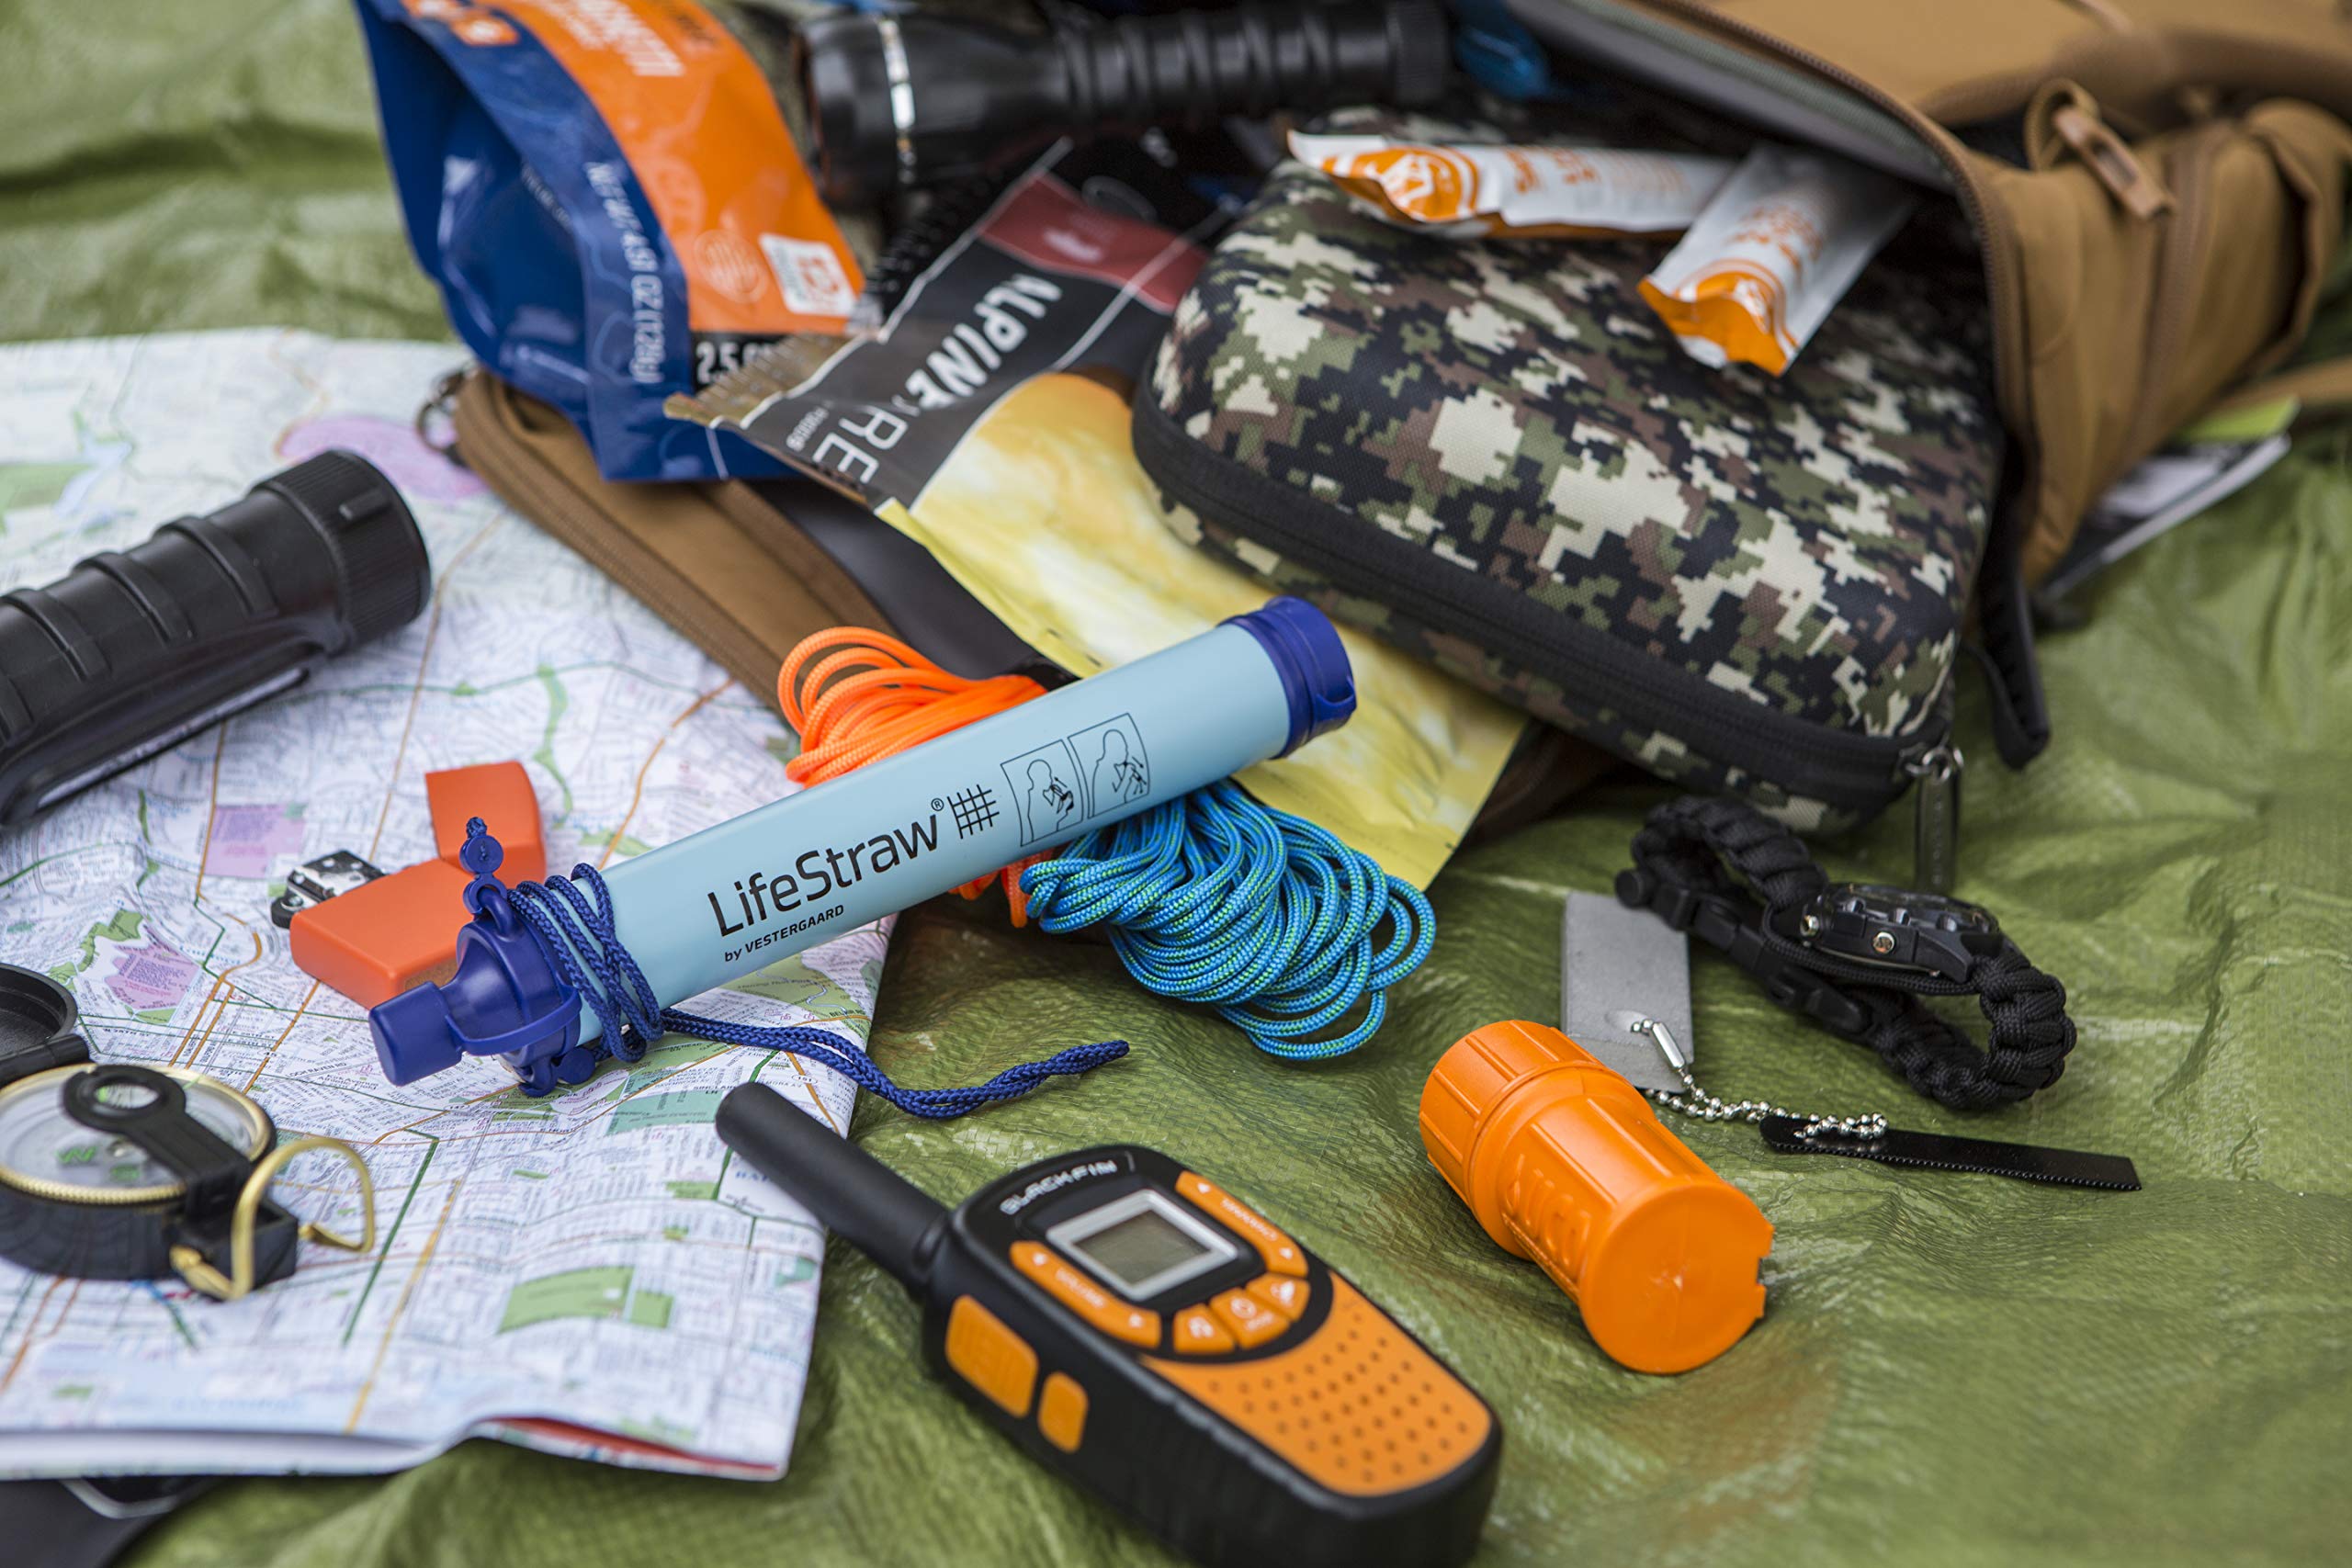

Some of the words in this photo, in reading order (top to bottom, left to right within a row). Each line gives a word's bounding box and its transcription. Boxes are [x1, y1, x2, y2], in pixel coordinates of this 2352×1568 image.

[904, 273, 1063, 411] ALPINE
[813, 397, 920, 485] RE
[724, 947, 742, 963] by
[743, 904, 845, 953] VESTERGAARD
